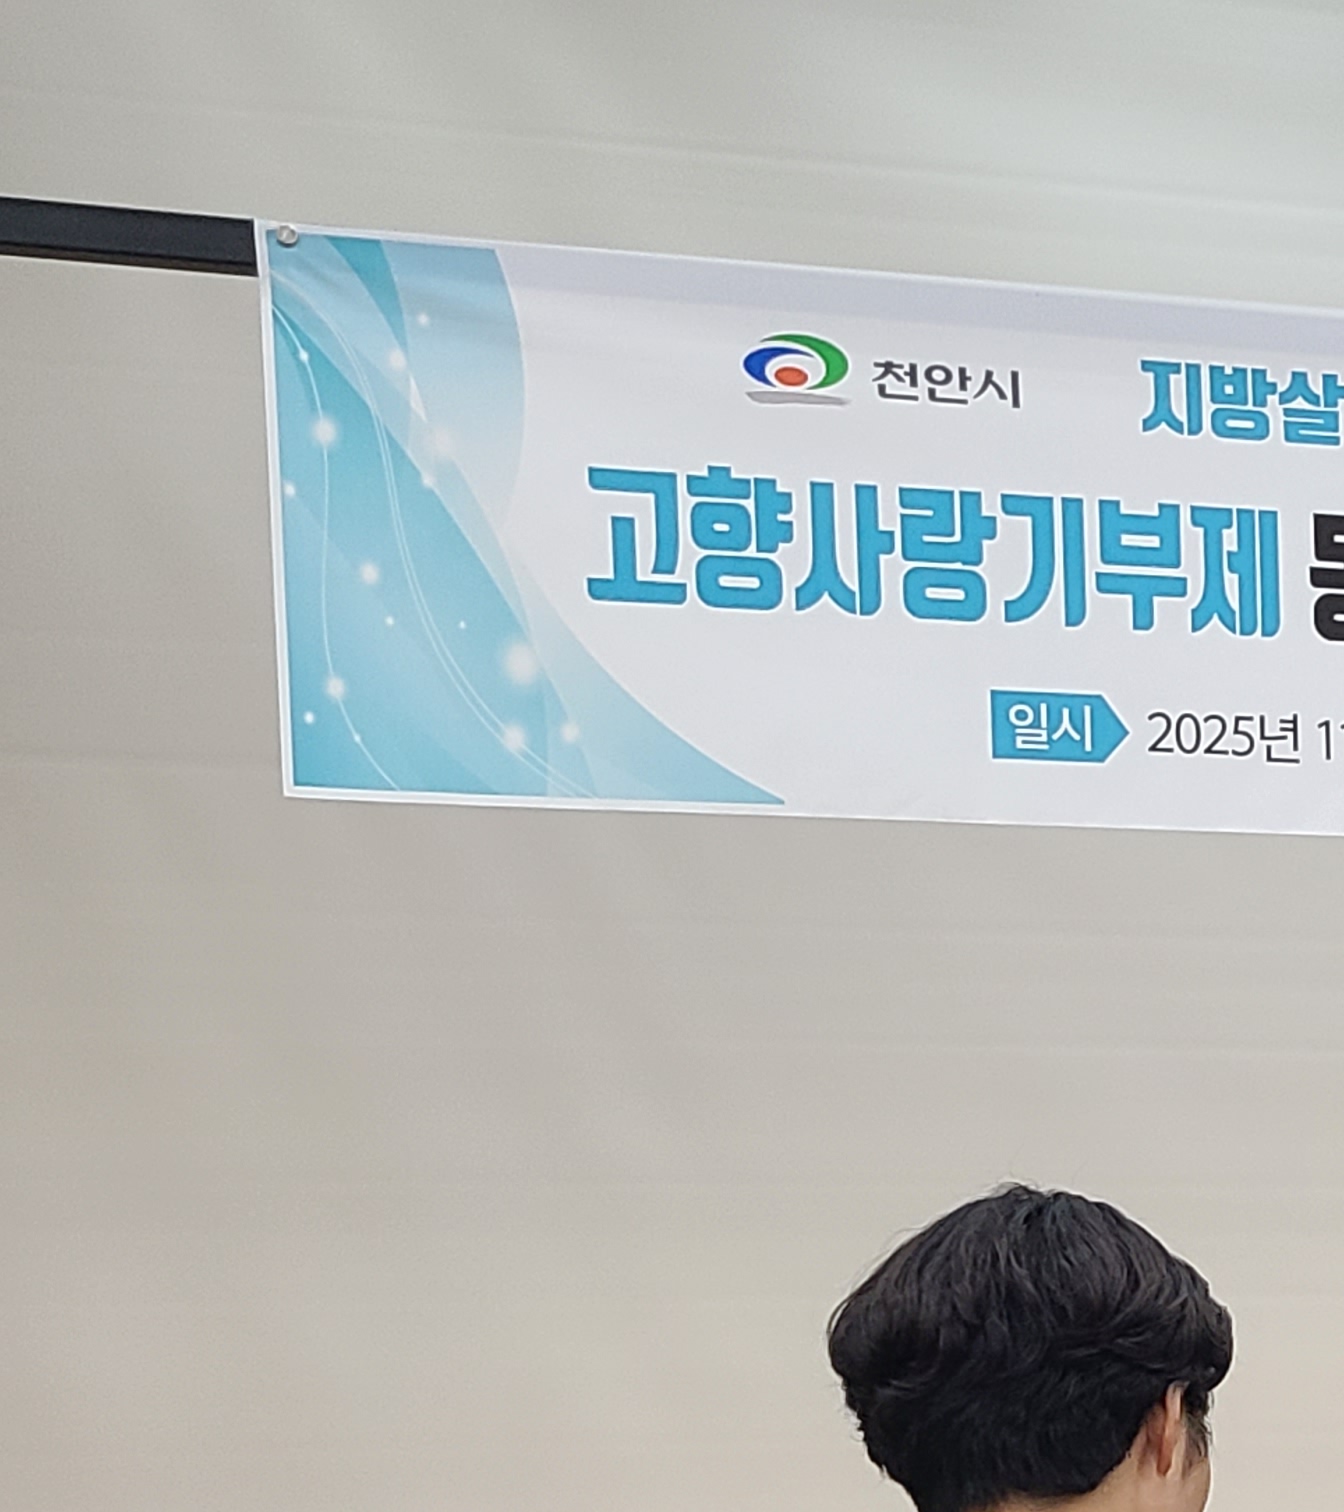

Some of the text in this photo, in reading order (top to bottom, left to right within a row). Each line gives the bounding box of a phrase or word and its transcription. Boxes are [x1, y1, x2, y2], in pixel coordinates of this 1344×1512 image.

[872, 359, 1021, 409] 천안시
[586, 464, 1281, 638] 고향사랑기부제
[1006, 699, 1094, 754] 일시
[1146, 711, 1301, 765] 2025년
